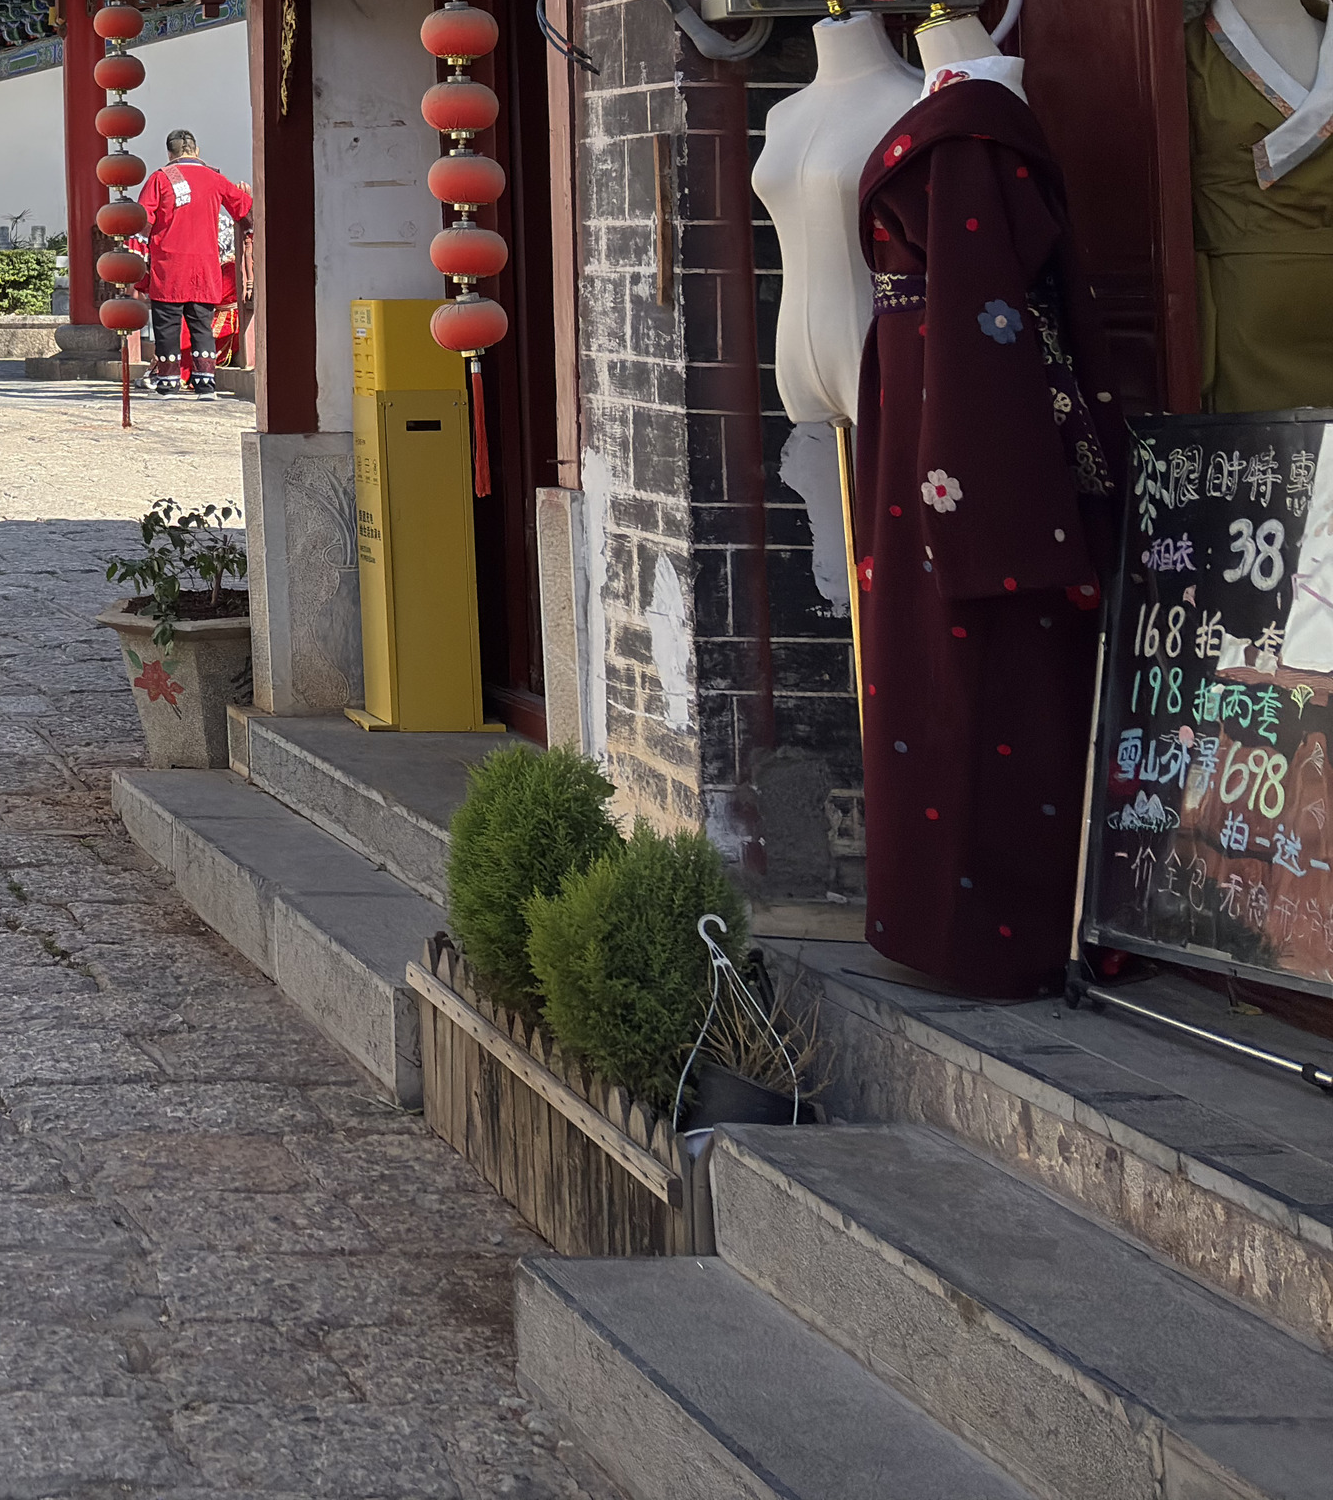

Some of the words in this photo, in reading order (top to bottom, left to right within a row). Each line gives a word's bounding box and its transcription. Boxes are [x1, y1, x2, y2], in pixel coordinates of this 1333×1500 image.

[1222, 518, 1286, 592] 38
[1134, 602, 1186, 659] 168
[1131, 665, 1183, 716] 198
[1191, 677, 1284, 746] 拍两套
[1116, 727, 1221, 793] 雪山外景
[1219, 740, 1289, 820] 698
[1219, 810, 1332, 878] 拍一送一
